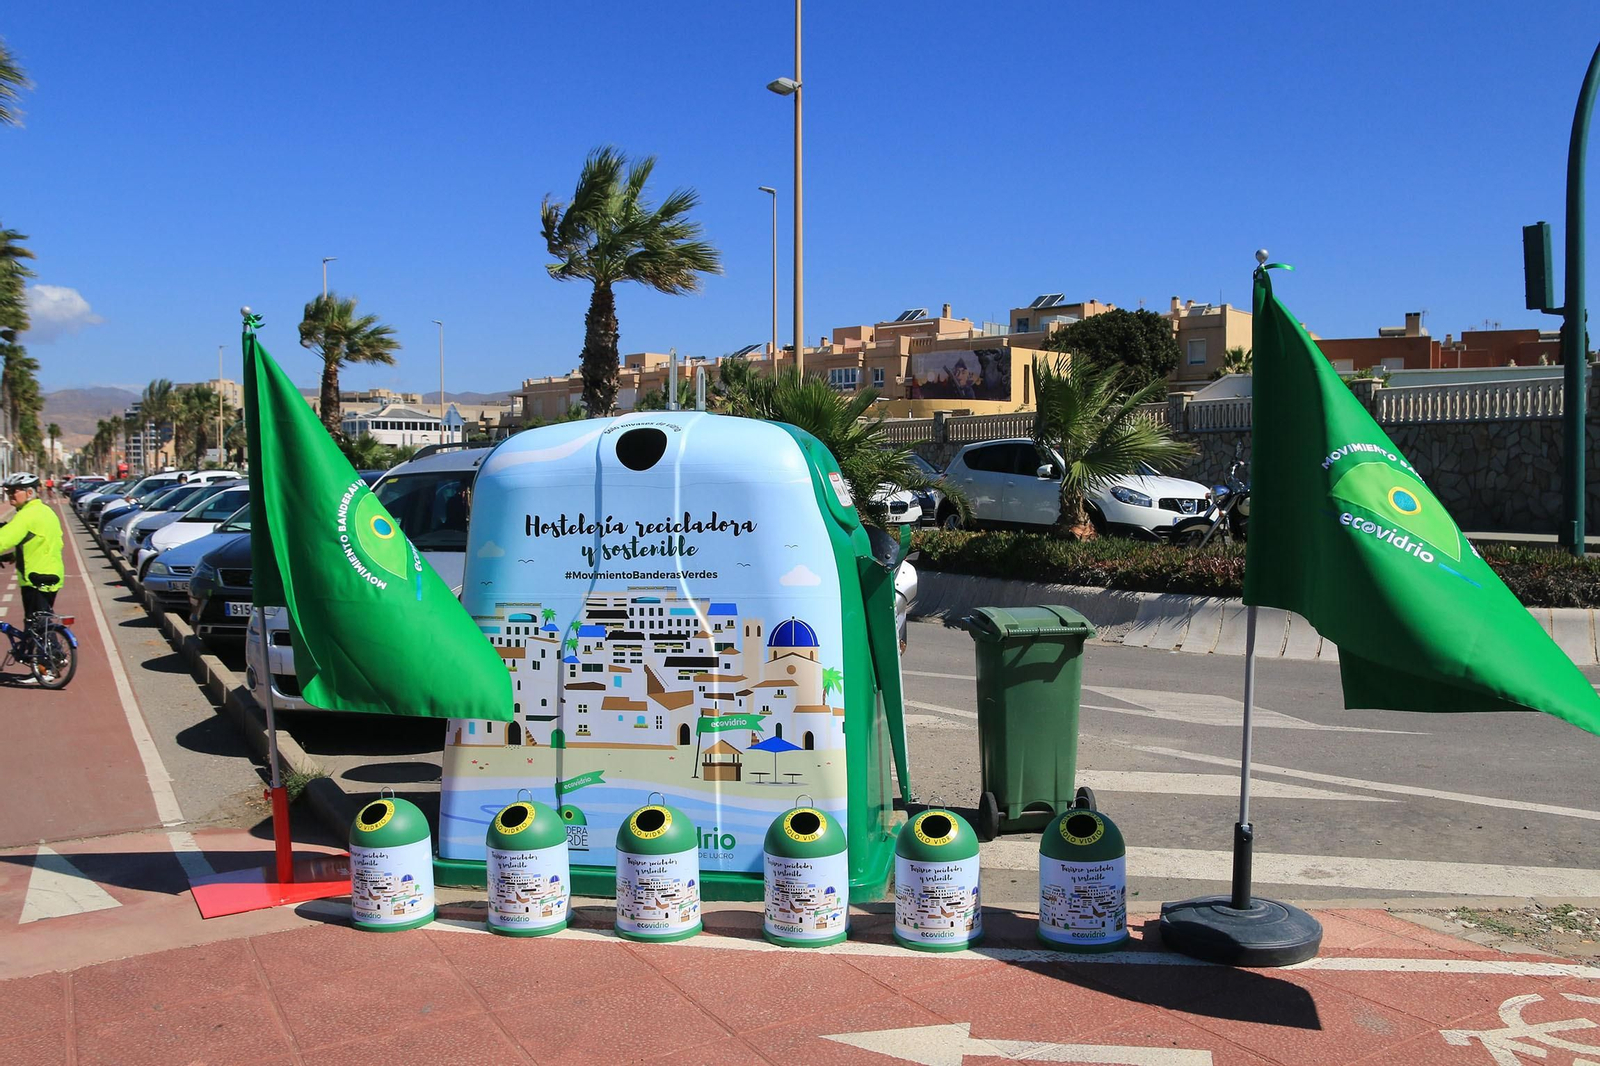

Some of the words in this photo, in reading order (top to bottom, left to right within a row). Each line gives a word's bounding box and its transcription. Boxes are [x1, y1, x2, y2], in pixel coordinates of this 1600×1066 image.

[1321, 443, 1398, 470] MOVIMIENTO
[337, 483, 359, 532] BANDERAS
[525, 512, 628, 538] Hostelería
[636, 511, 757, 538] recicladora
[1339, 512, 1435, 564] ecovidrio
[581, 543, 596, 567] y
[602, 535, 699, 561] sostenible
[340, 534, 388, 590] MOVIMIENTO
[565, 570, 718, 580] #MovimientoBanderasVerdes
[711, 717, 747, 728] ecovidrio
[563, 776, 592, 790] ecovidrio
[565, 826, 589, 835] DERA
[567, 834, 589, 847] RDE
[710, 852, 735, 860] LUCRO
[499, 913, 530, 922] ecovidrio
[636, 921, 670, 929] ecovidrio
[773, 923, 804, 933] ecovidrio
[920, 930, 955, 938] ecovidrio
[1071, 930, 1107, 938] ecovidrio
